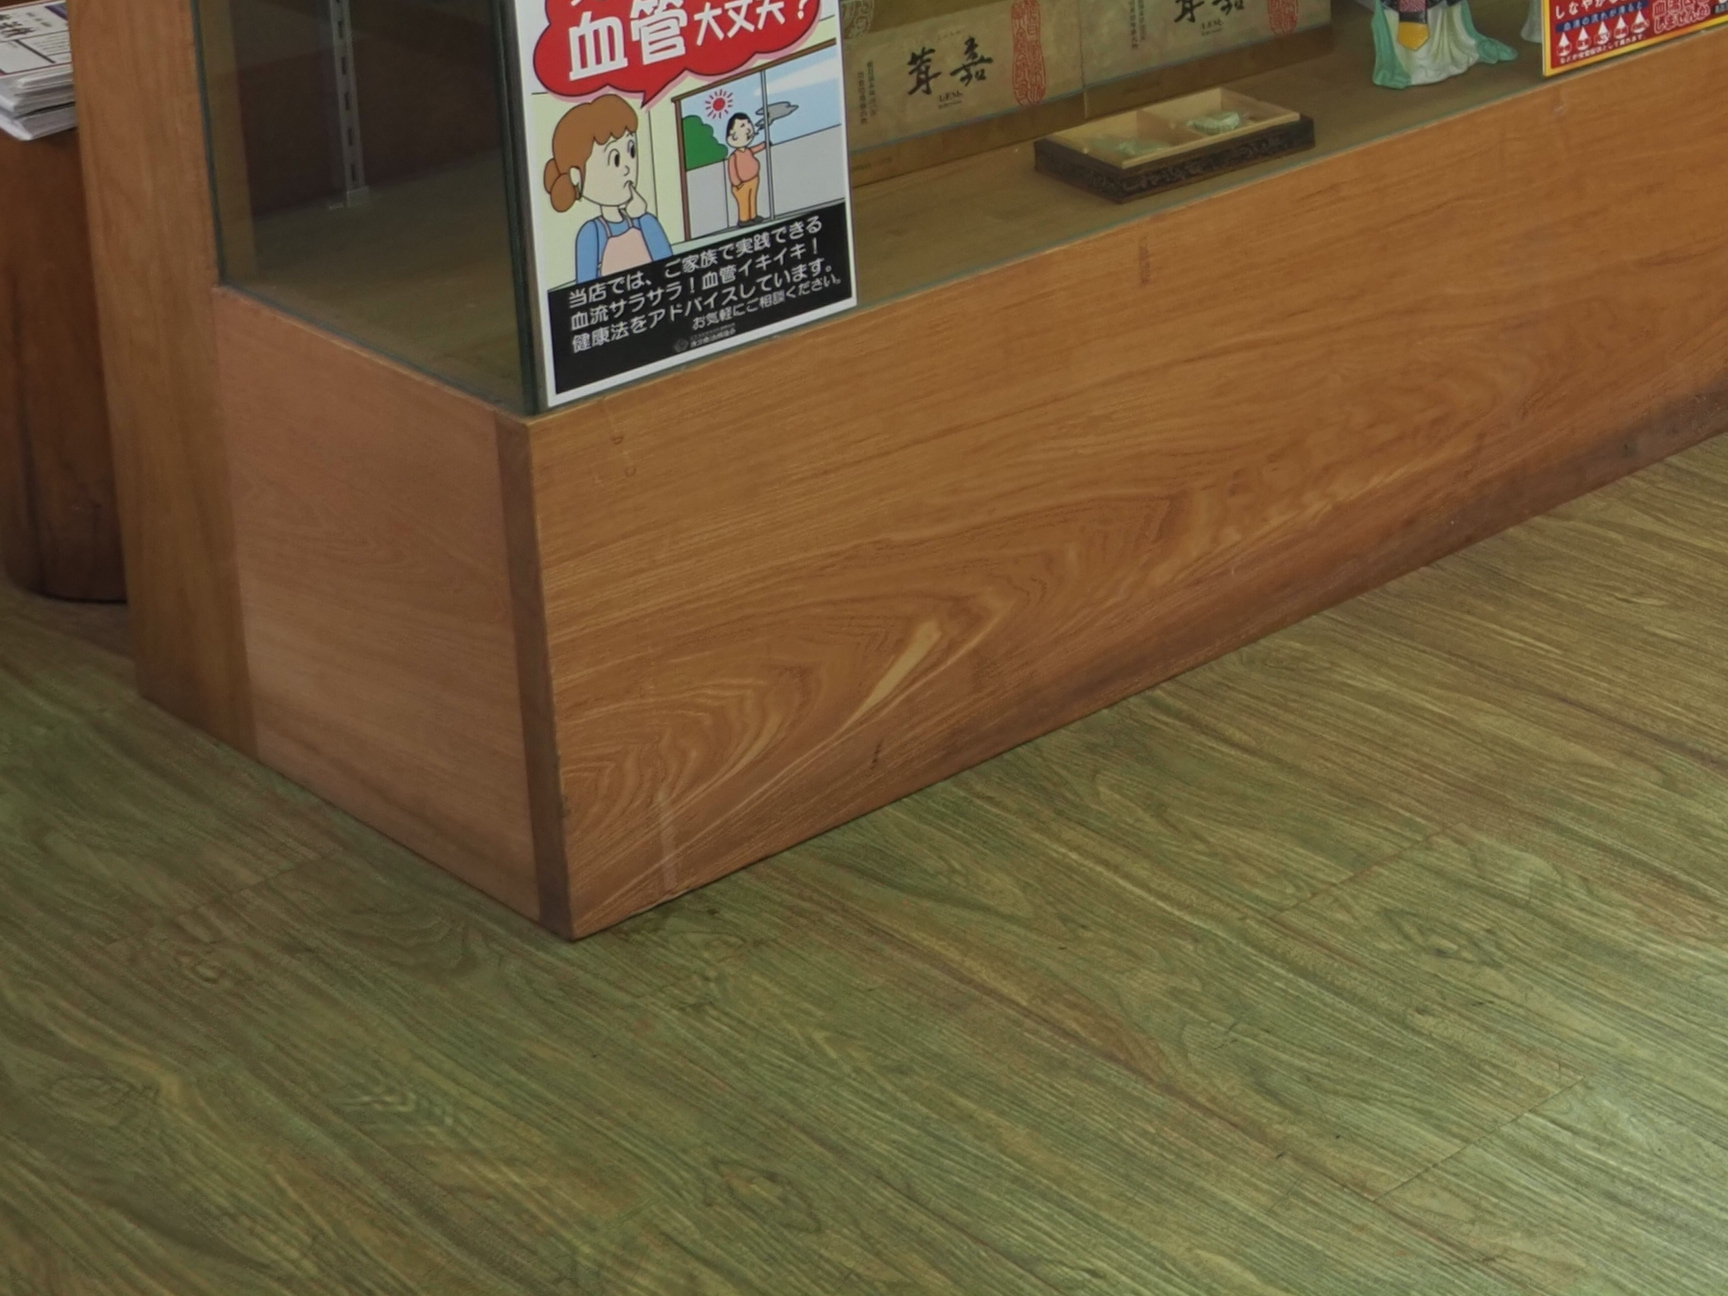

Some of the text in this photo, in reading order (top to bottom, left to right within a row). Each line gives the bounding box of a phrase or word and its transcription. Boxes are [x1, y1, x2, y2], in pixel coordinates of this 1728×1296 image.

[567, 213, 824, 310] 当店では、ご家族で実践できる
[571, 258, 834, 355] 健康法をアドバイスしています。
